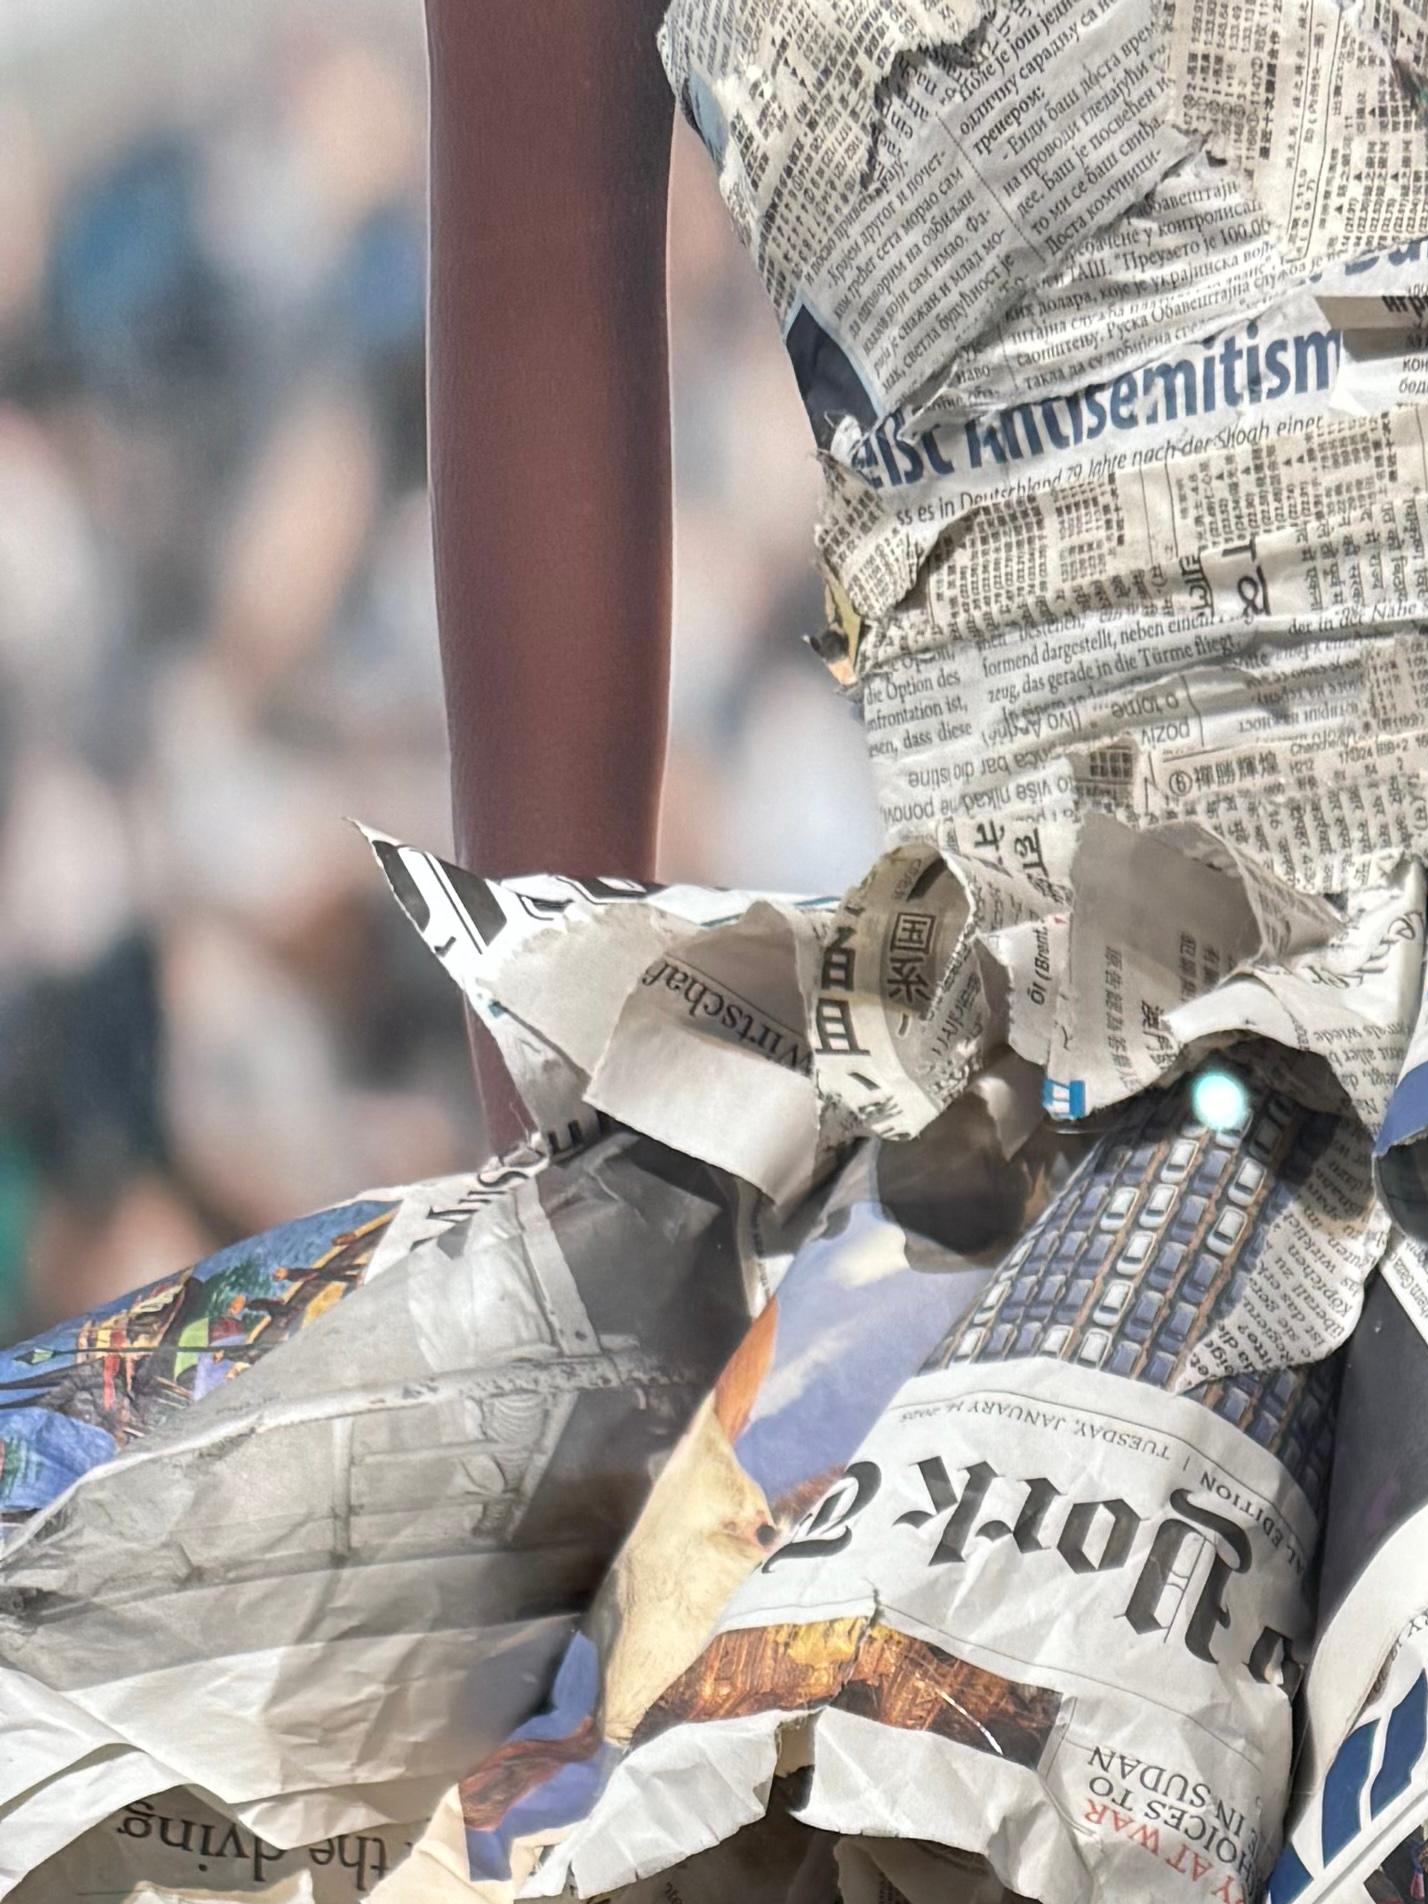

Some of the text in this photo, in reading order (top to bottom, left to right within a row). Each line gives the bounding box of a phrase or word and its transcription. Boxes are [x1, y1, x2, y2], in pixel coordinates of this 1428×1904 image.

[966, 1399, 1068, 1432] JANUARY
[1073, 1418, 1171, 1462] TUESDAY,
[895, 1451, 1254, 1668] York
